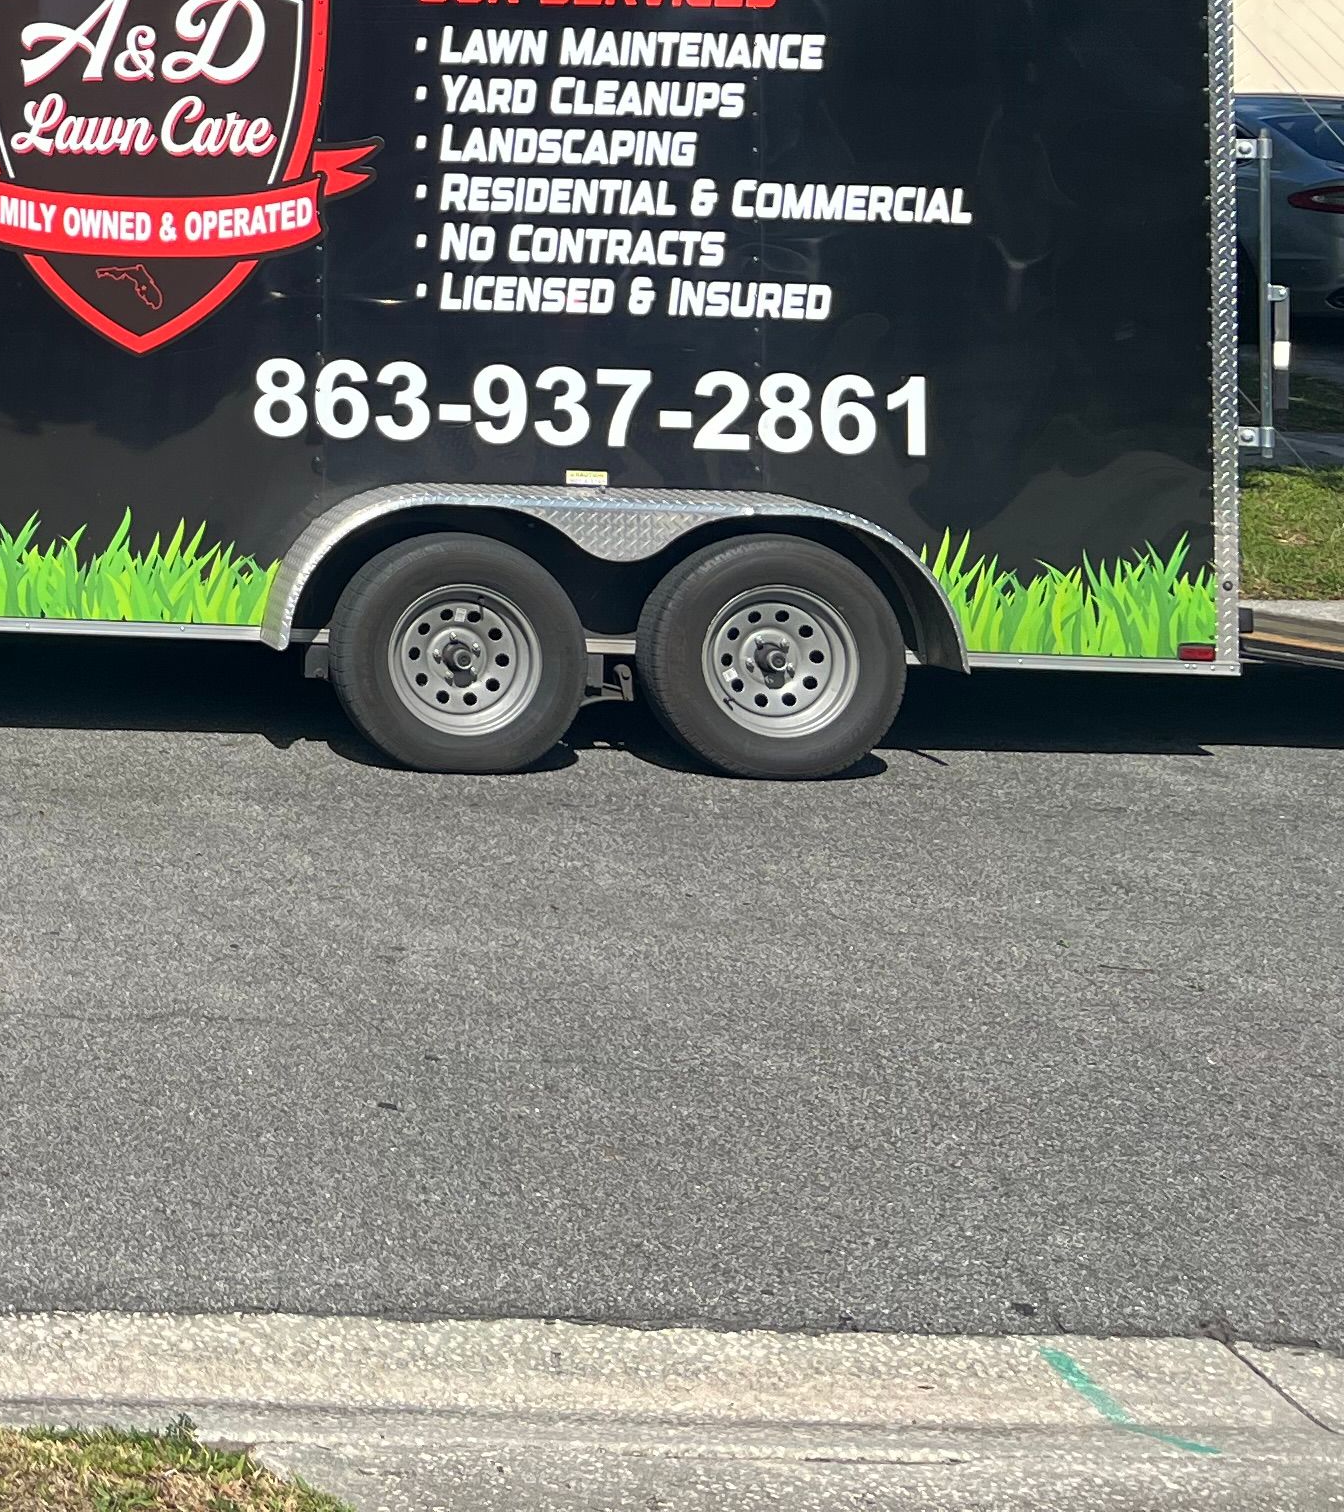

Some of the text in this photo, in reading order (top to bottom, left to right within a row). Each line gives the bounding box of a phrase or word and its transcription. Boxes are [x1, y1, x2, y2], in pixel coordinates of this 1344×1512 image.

[439, 25, 826, 70] LAWN MAINTENANCE
[441, 74, 746, 119] YARD CLEANUPS
[10, 92, 278, 157] Lawn Care
[439, 123, 698, 167] LANDSCAPING
[63, 206, 152, 242] OWNED
[158, 211, 178, 243] &
[184, 196, 313, 242] OPERATED
[439, 172, 973, 224] RESIDENTIAL & COMMERCIAL
[439, 222, 726, 267] NO CONTRACTS
[439, 271, 832, 321] LICENSED & INSURED
[253, 357, 929, 457] 863-937-2861
